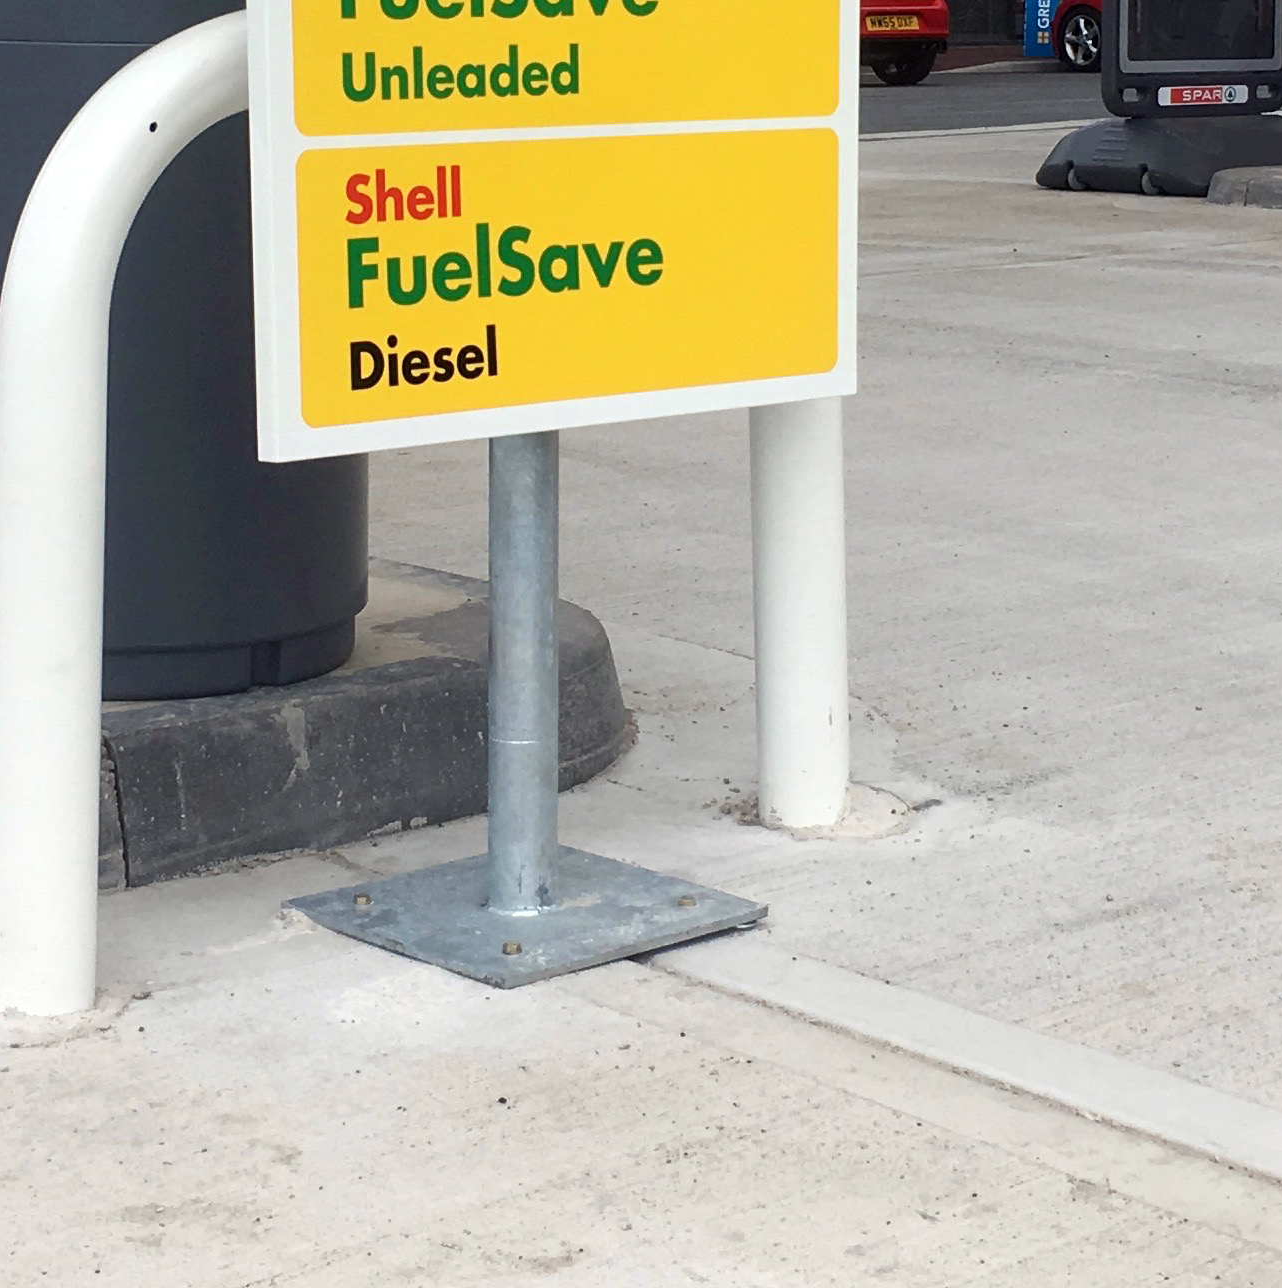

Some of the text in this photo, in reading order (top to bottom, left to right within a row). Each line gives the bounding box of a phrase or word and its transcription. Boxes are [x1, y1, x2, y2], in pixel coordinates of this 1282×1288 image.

[342, 43, 579, 103] Unleaded
[1182, 89, 1223, 102] SPAR
[345, 164, 462, 225] Shell
[346, 222, 664, 309] FuelSave
[349, 324, 498, 391] Diesel
